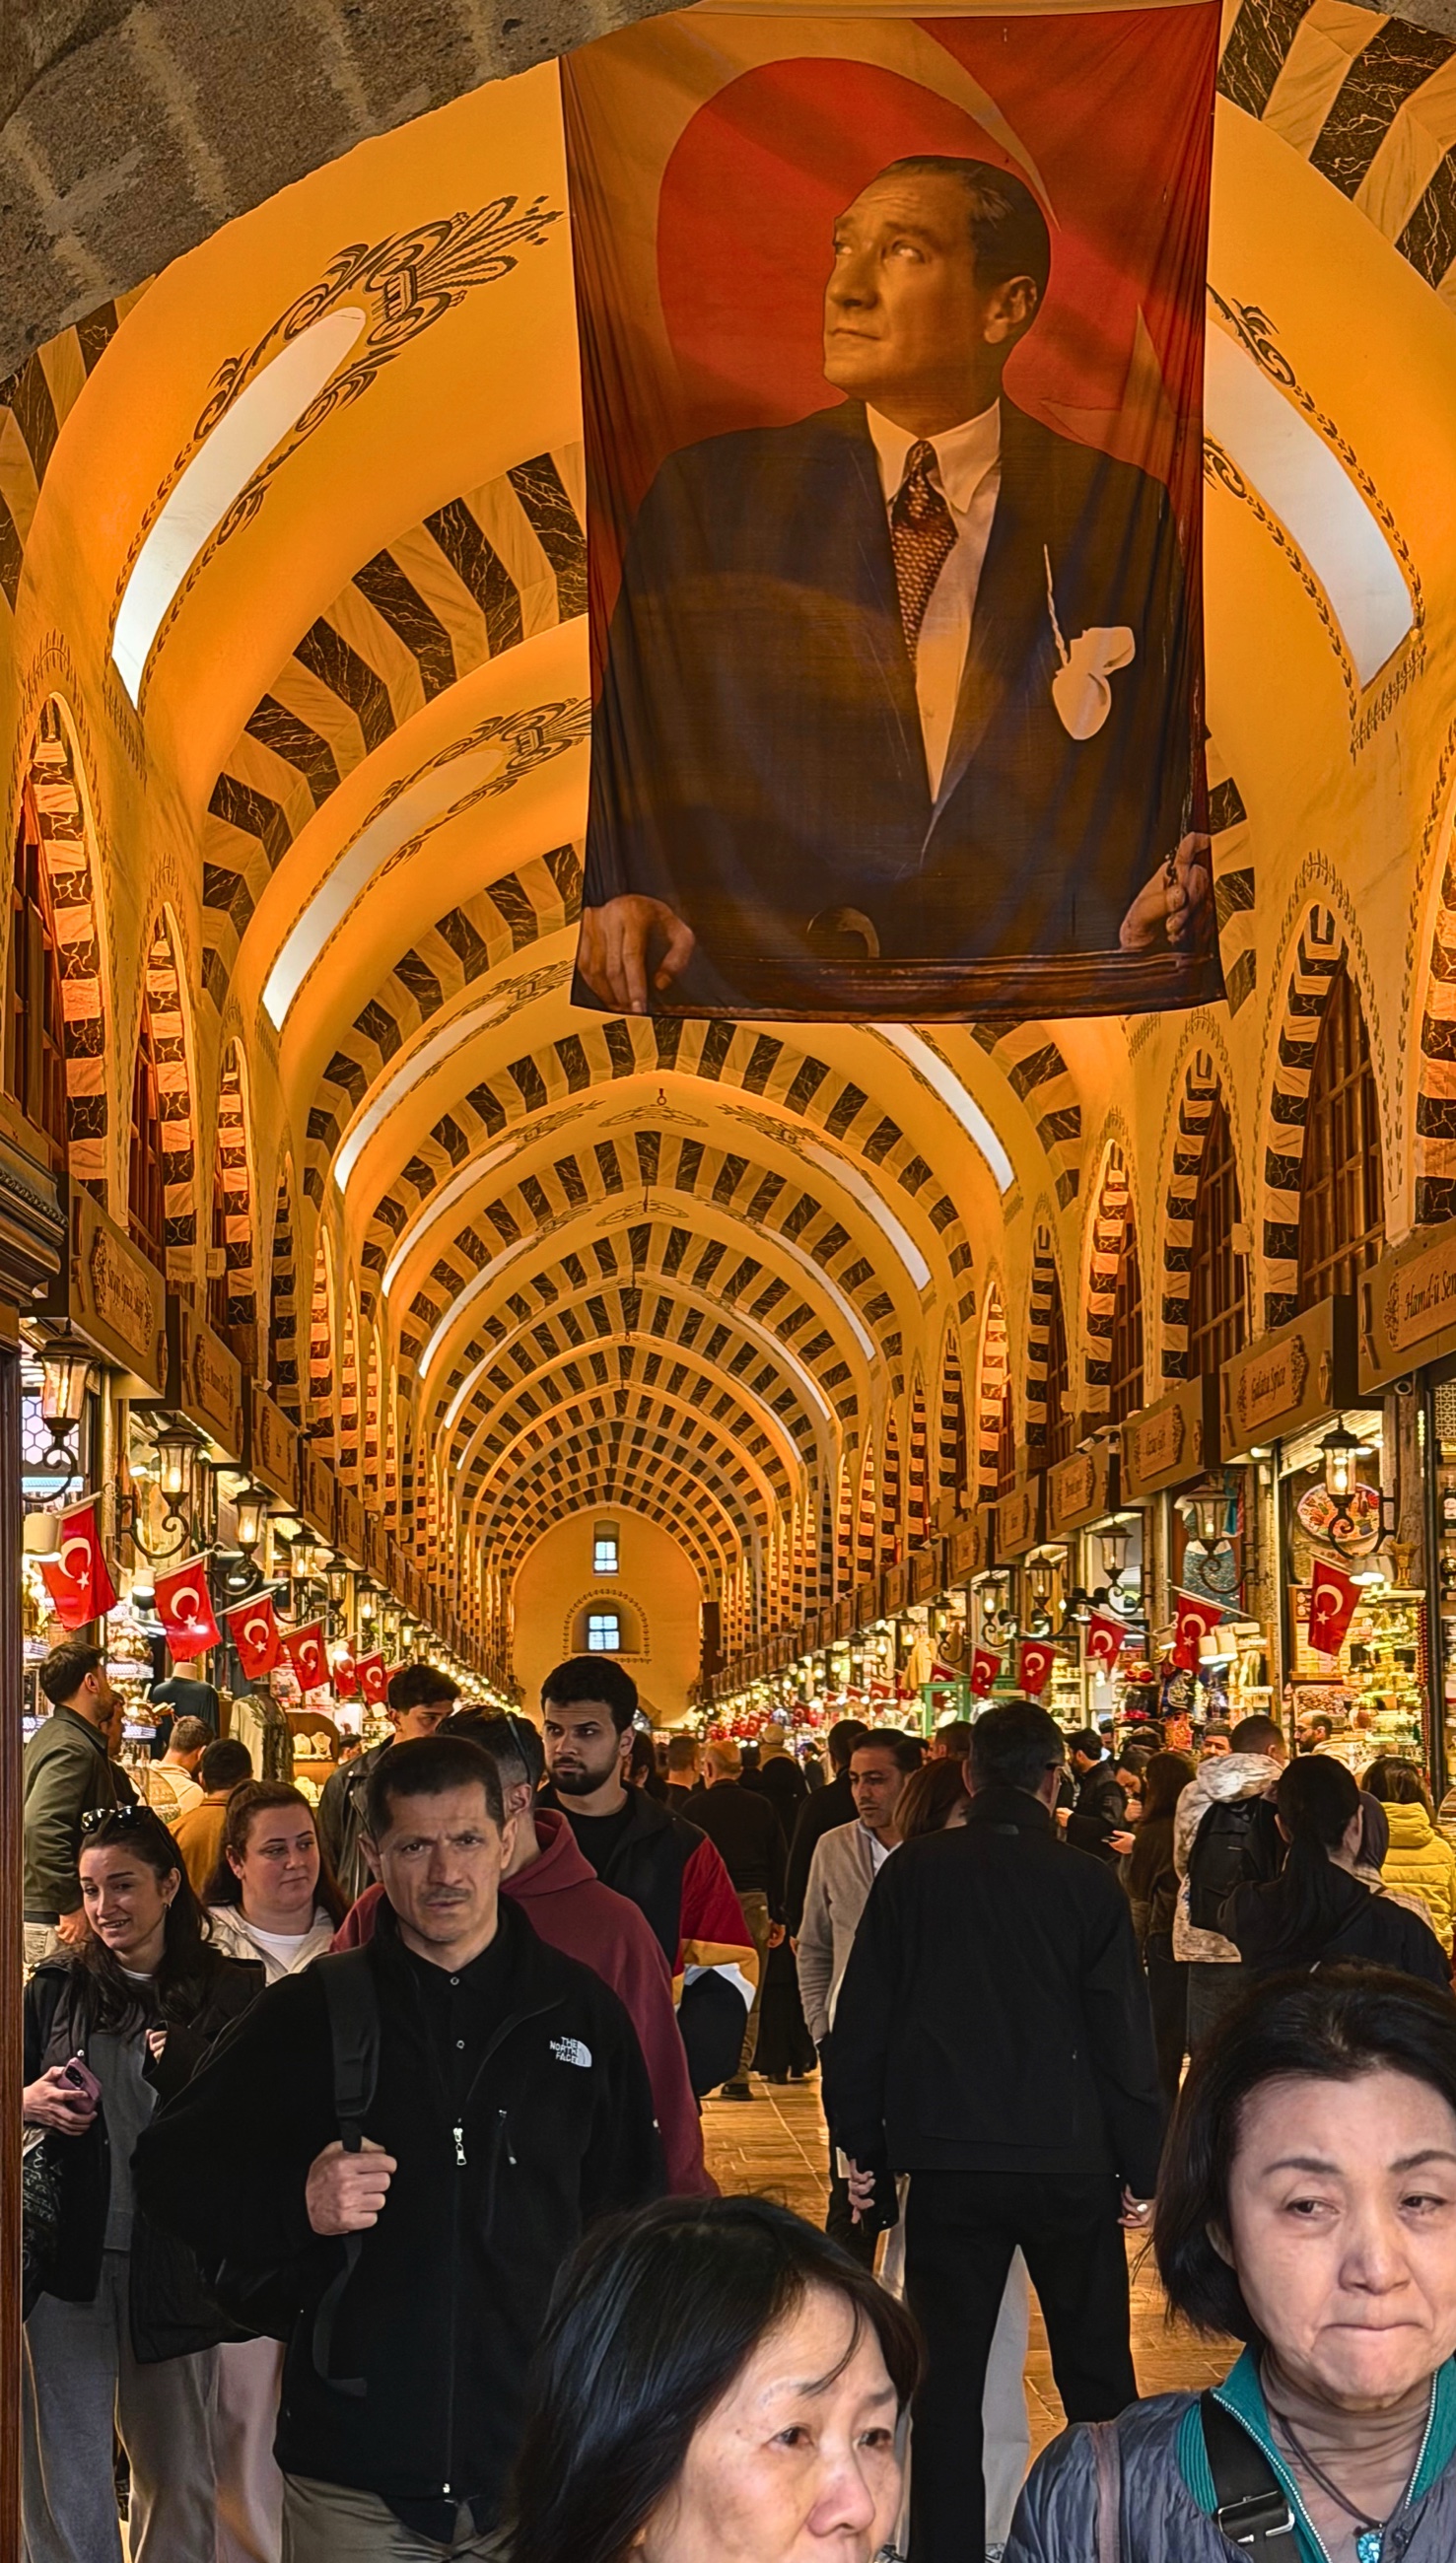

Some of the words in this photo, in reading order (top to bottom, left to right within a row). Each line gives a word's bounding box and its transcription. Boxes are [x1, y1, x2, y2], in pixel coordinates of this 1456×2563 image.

[549, 2040, 578, 2057] NORTH
[561, 2036, 578, 2050] THE
[555, 2051, 578, 2064] FACE
